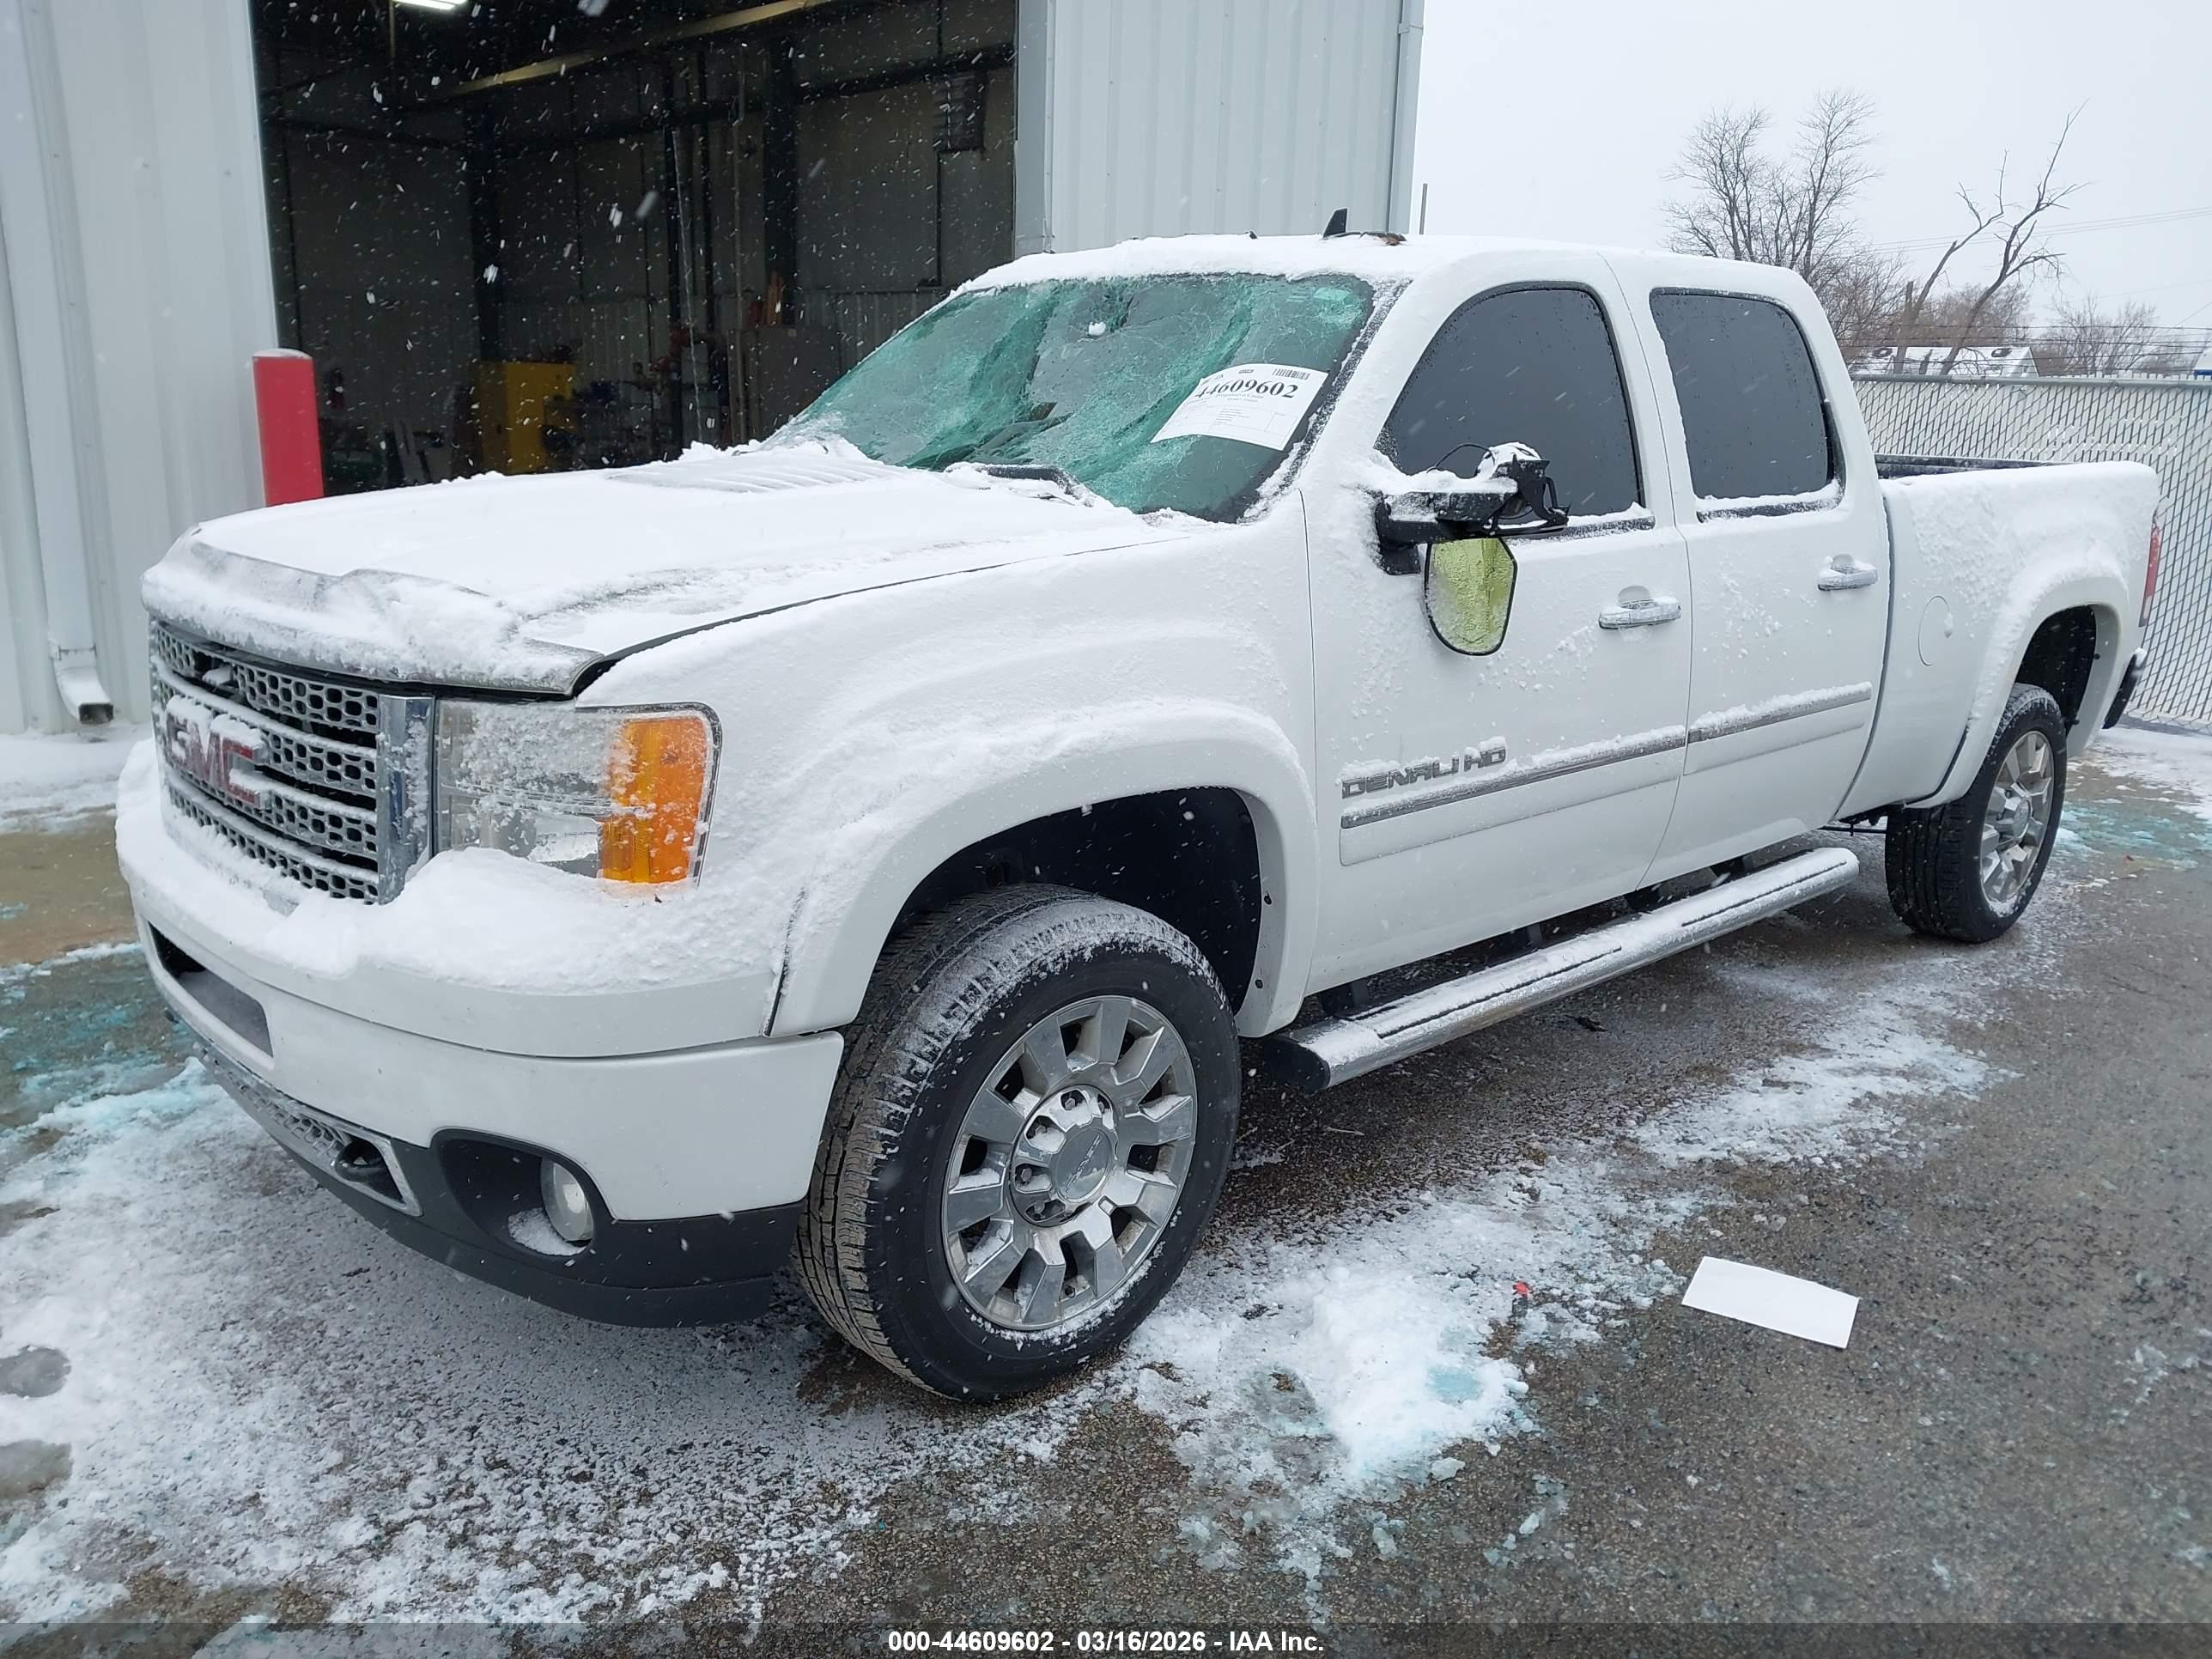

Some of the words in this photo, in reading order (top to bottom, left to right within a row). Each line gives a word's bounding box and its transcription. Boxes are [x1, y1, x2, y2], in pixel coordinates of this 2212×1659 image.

[164, 700, 268, 809] GMC
[1341, 756, 1460, 799] DENALI
[1463, 746, 1506, 772] HD
